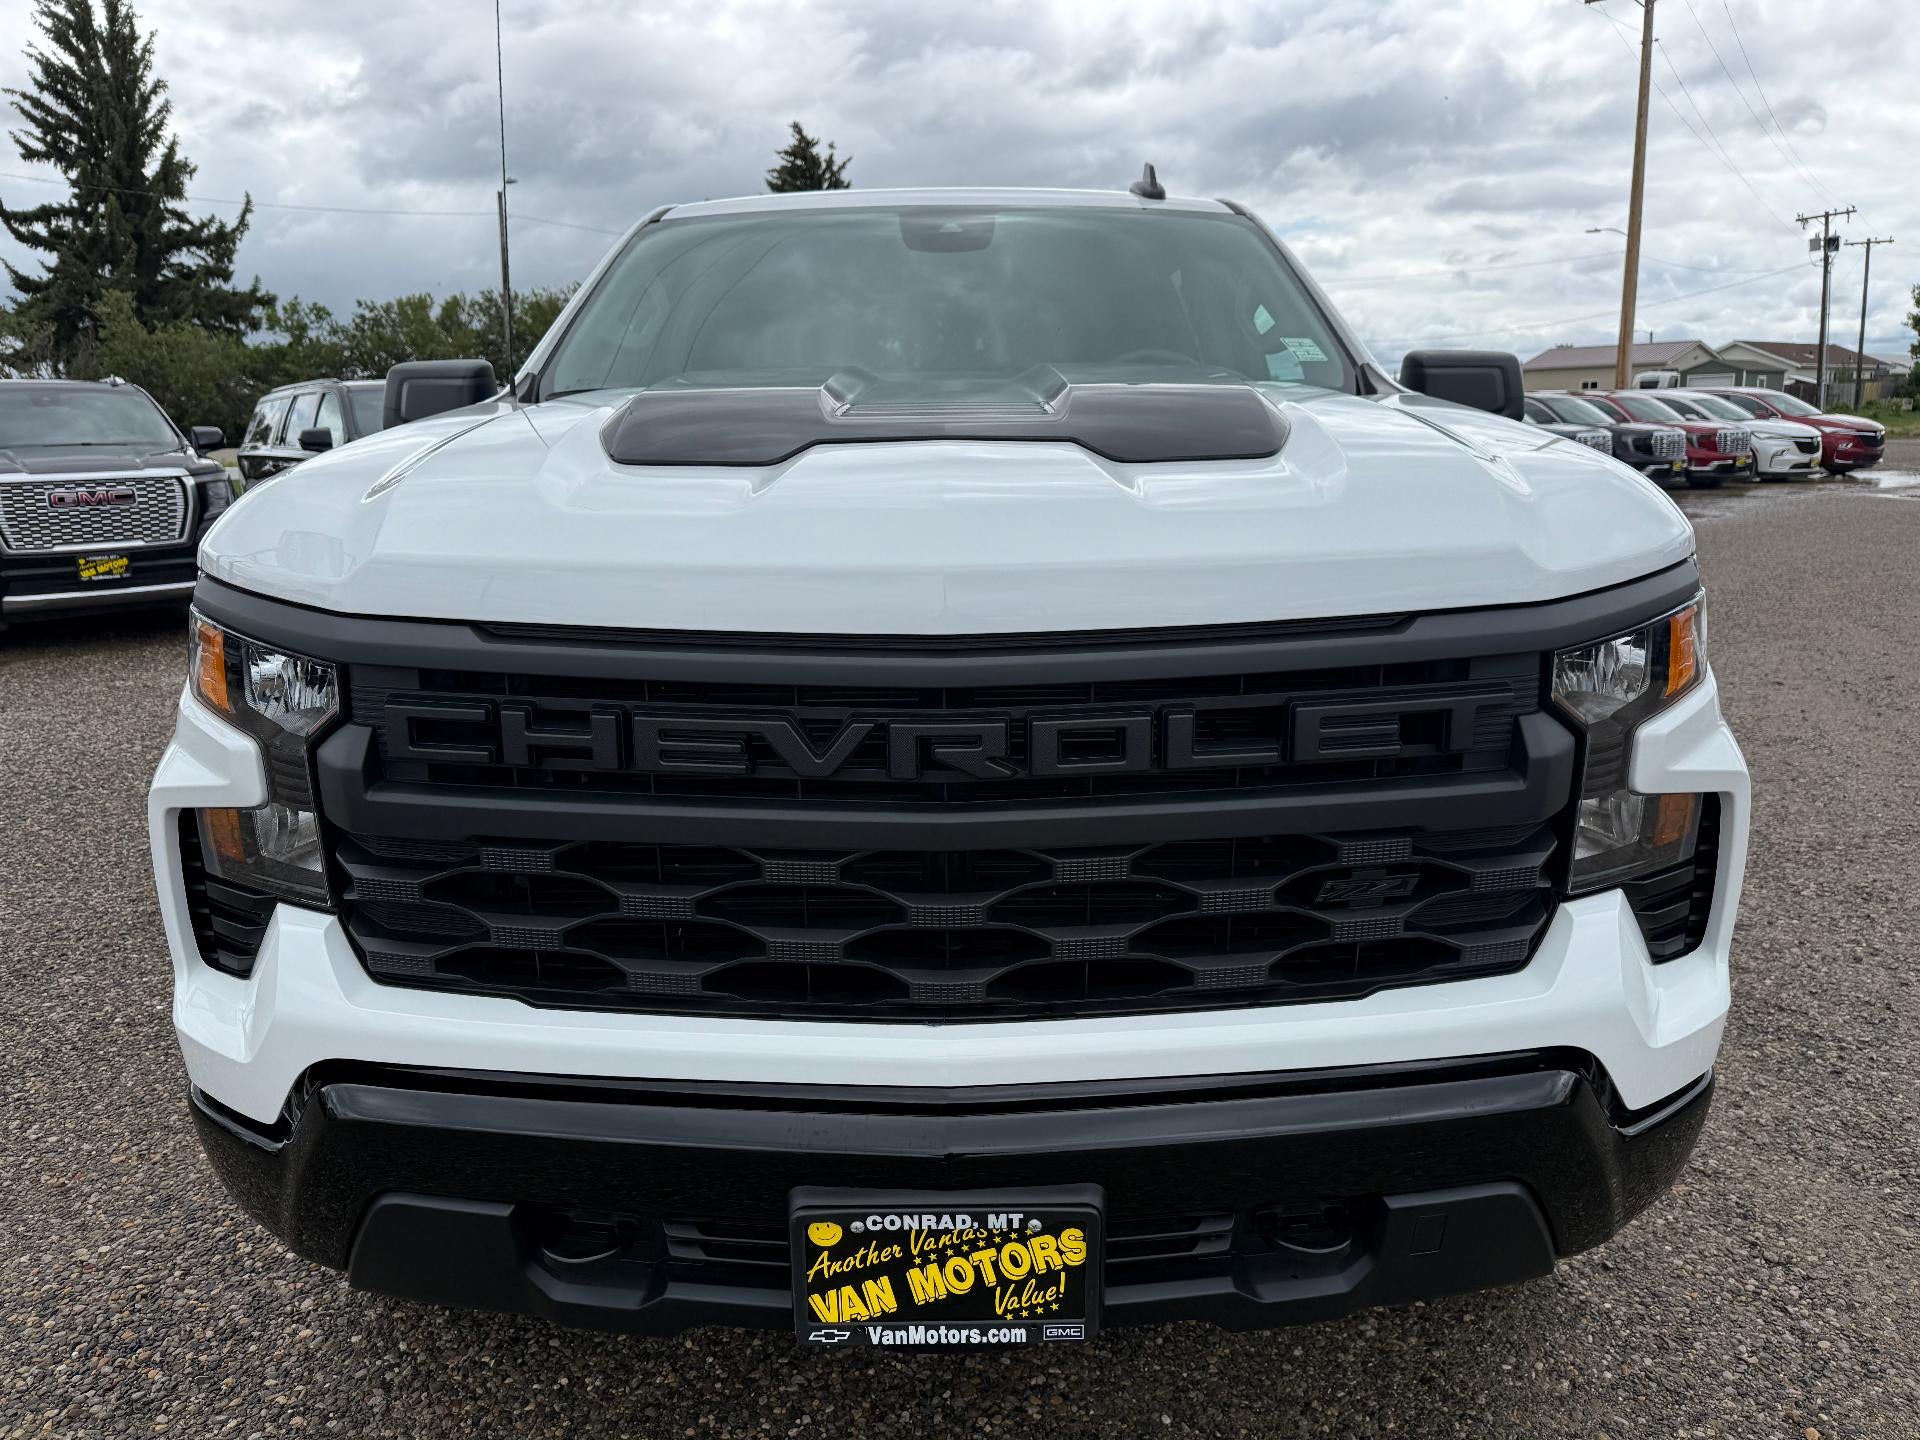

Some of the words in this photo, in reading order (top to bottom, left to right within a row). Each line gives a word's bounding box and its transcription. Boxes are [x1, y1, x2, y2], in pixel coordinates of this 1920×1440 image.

[51, 490, 133, 508] GMC
[384, 683, 1517, 780] CHEVROLET
[866, 1214, 979, 1231] CONRAD,
[988, 1213, 1024, 1229] MT
[807, 1240, 902, 1283] Another
[808, 1275, 898, 1323] VAN
[906, 1227, 1087, 1306] MOTORS
[994, 1271, 1066, 1316] Value!
[868, 1325, 1027, 1345] VanMotors.com
[1046, 1327, 1082, 1338] GMC
